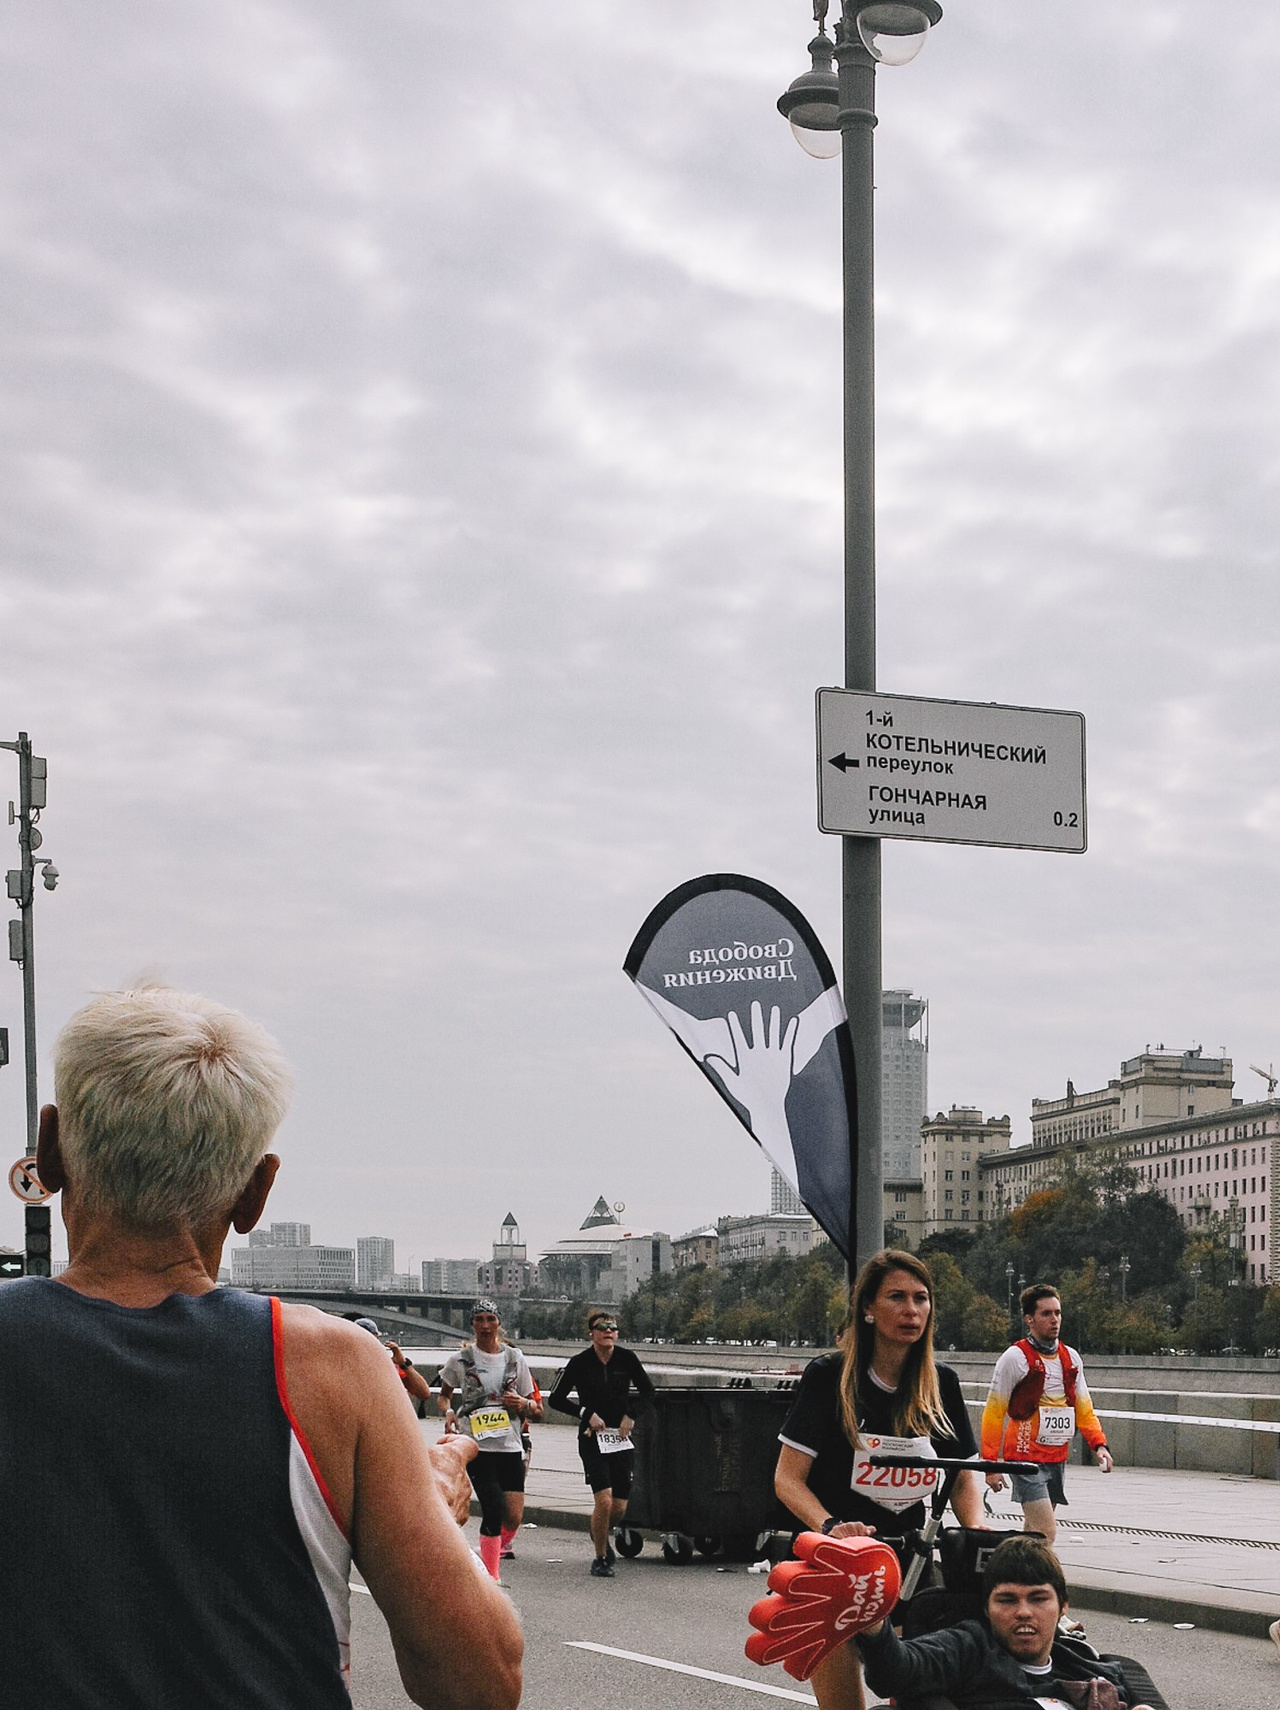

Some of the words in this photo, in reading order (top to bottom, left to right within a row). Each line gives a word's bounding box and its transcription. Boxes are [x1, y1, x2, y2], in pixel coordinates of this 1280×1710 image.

[865, 709, 894, 728] 1-й
[866, 732, 1047, 764] КОТЕЛЬНИЧЕСКИЙ
[866, 755, 954, 775] переулок
[868, 785, 988, 811] ГОНЧАРНАЯ
[868, 807, 925, 825] улица
[1053, 811, 1079, 828] 0.2
[476, 1414, 505, 1425] 1944
[1045, 1417, 1070, 1429] 7303
[855, 1461, 937, 1487] 22058
